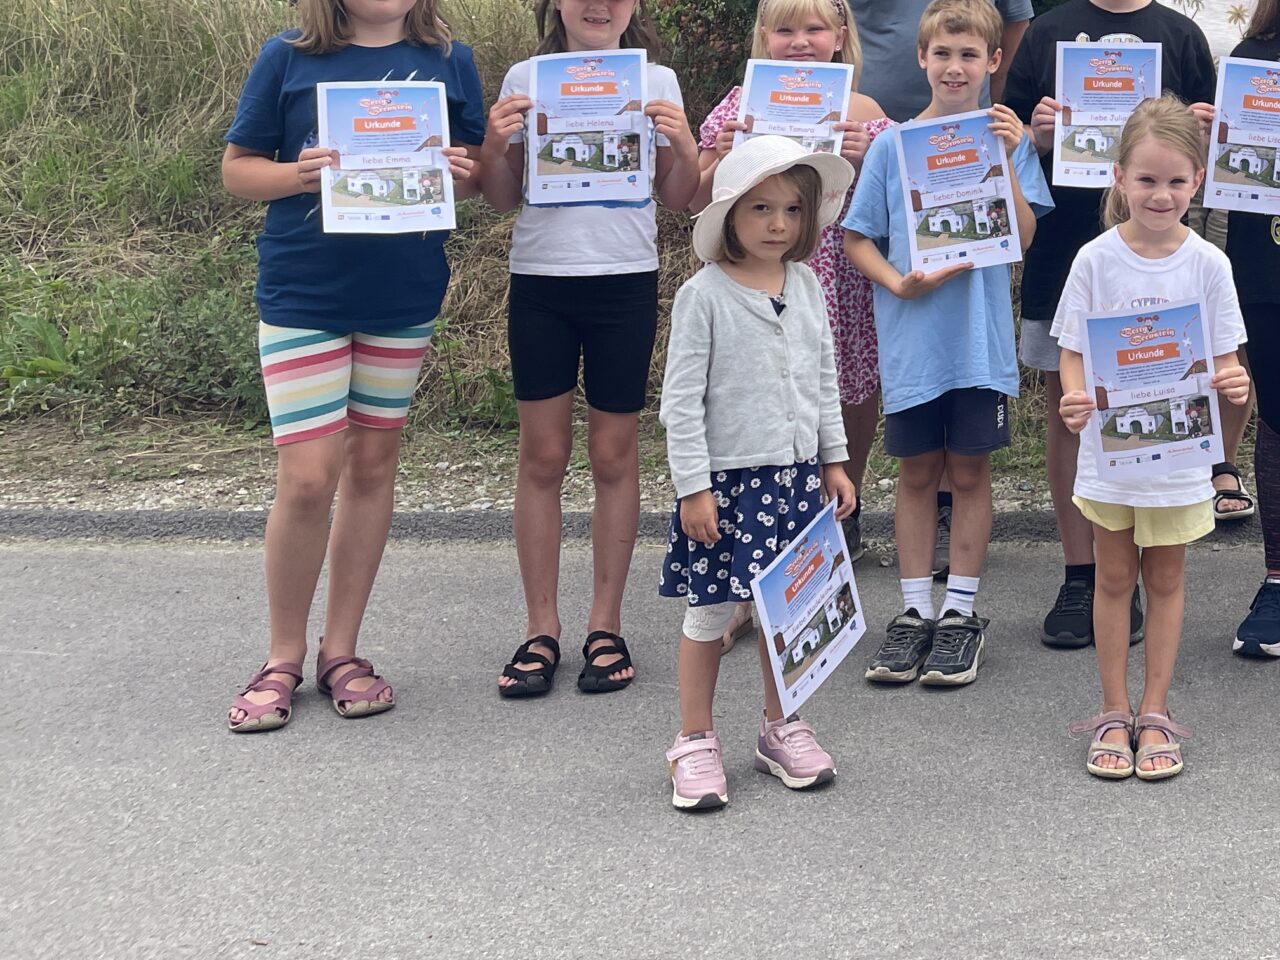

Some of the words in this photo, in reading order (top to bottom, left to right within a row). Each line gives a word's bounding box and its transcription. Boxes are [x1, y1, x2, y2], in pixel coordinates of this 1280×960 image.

[1092, 80, 1123, 88] Urkunde
[570, 85, 604, 93] Urkunde
[779, 94, 810, 102] Urkunde
[365, 120, 401, 129] Urkunde
[566, 120, 585, 128] liebe
[586, 119, 614, 127] Helena
[768, 124, 787, 132] liebe
[788, 125, 815, 133] Tamara
[1249, 134, 1266, 143] liebe
[363, 156, 383, 164] liebe
[936, 154, 966, 166] Urkunde
[934, 192, 953, 202] lieber
[956, 188, 984, 198] Dominik
[1128, 349, 1165, 361] Urkunde
[1131, 390, 1151, 400] liebe
[1153, 386, 1175, 396] Luisa
[792, 564, 815, 594] Urkunde
[792, 616, 807, 634] liebe
